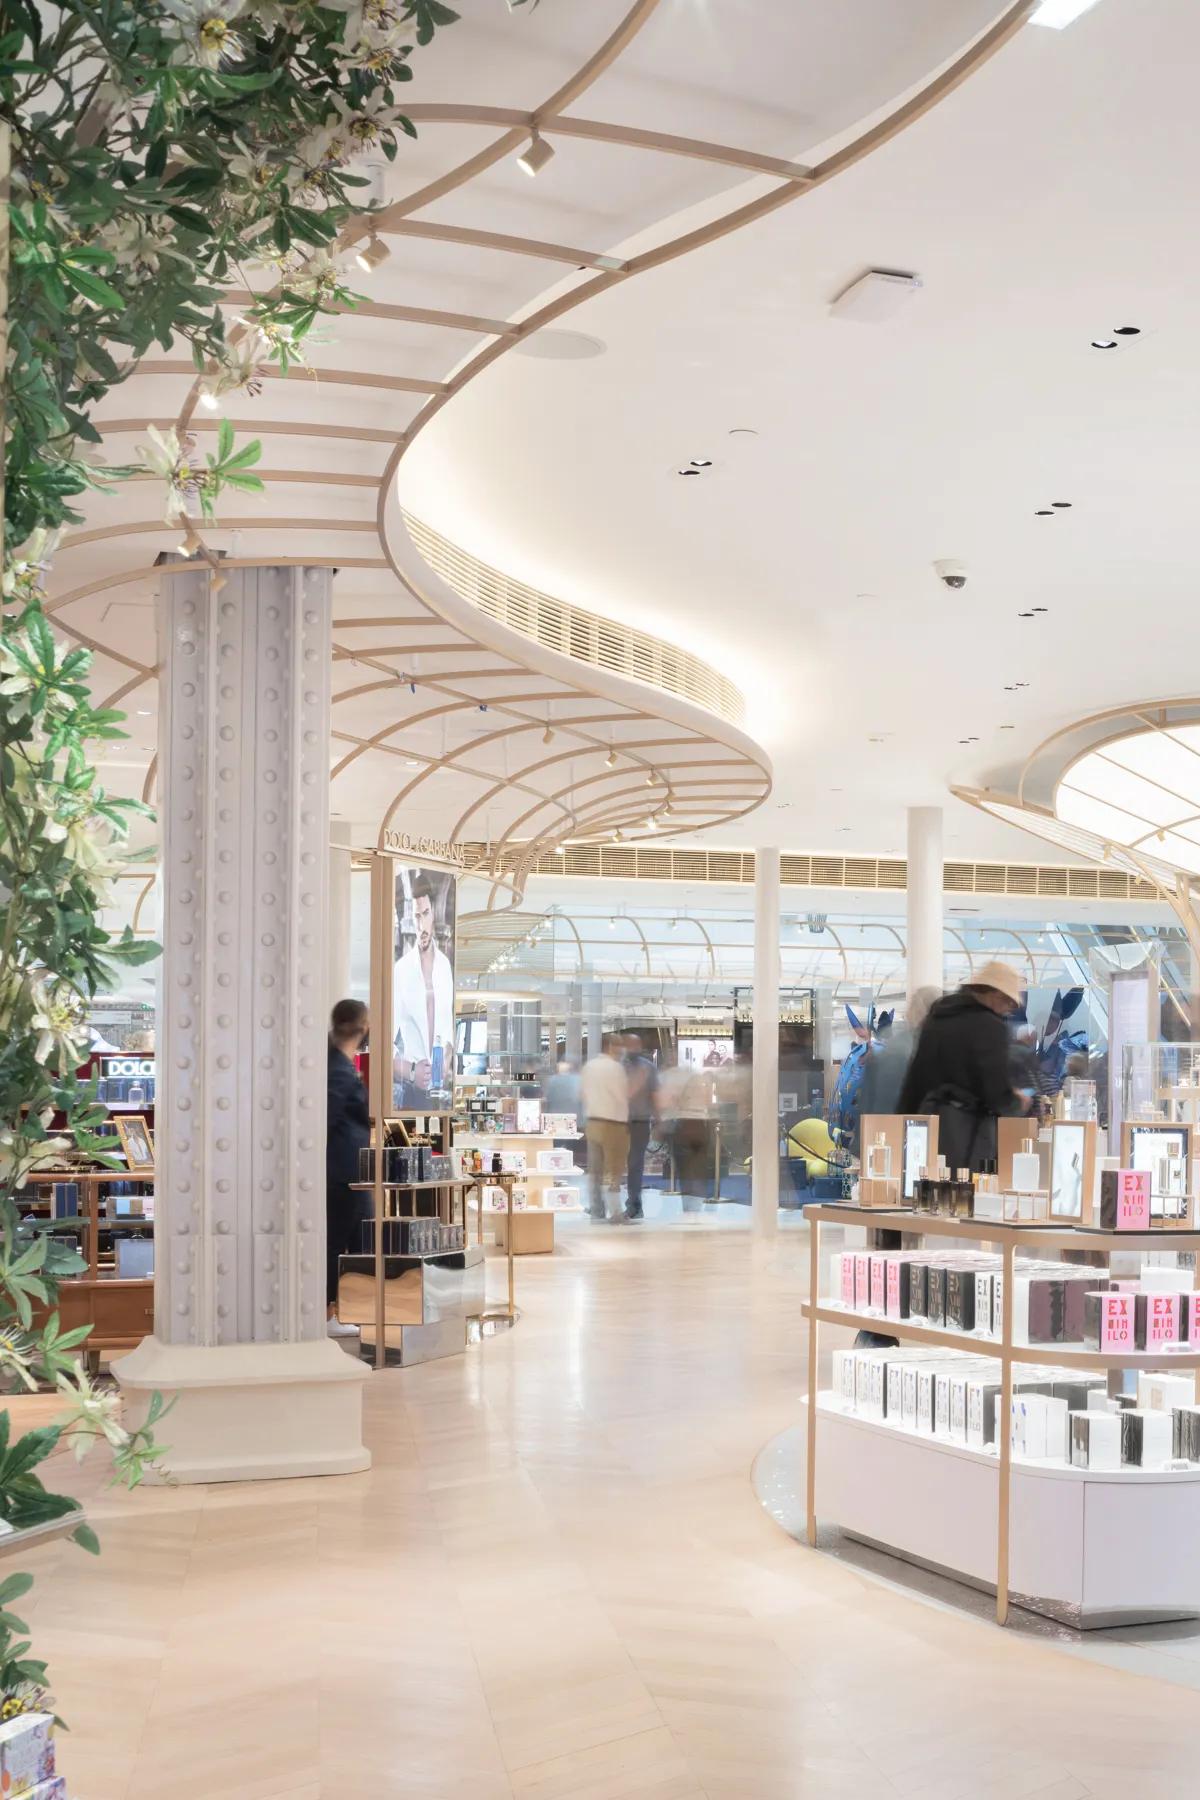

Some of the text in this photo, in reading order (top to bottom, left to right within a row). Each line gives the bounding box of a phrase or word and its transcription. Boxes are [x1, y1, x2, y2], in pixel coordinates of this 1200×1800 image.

[1124, 1175, 1144, 1191] EX
[1108, 1299, 1128, 1315] EX
[1153, 1298, 1173, 1314] EX
[1108, 1330, 1128, 1341] ILO
[1153, 1329, 1173, 1339] ILO
